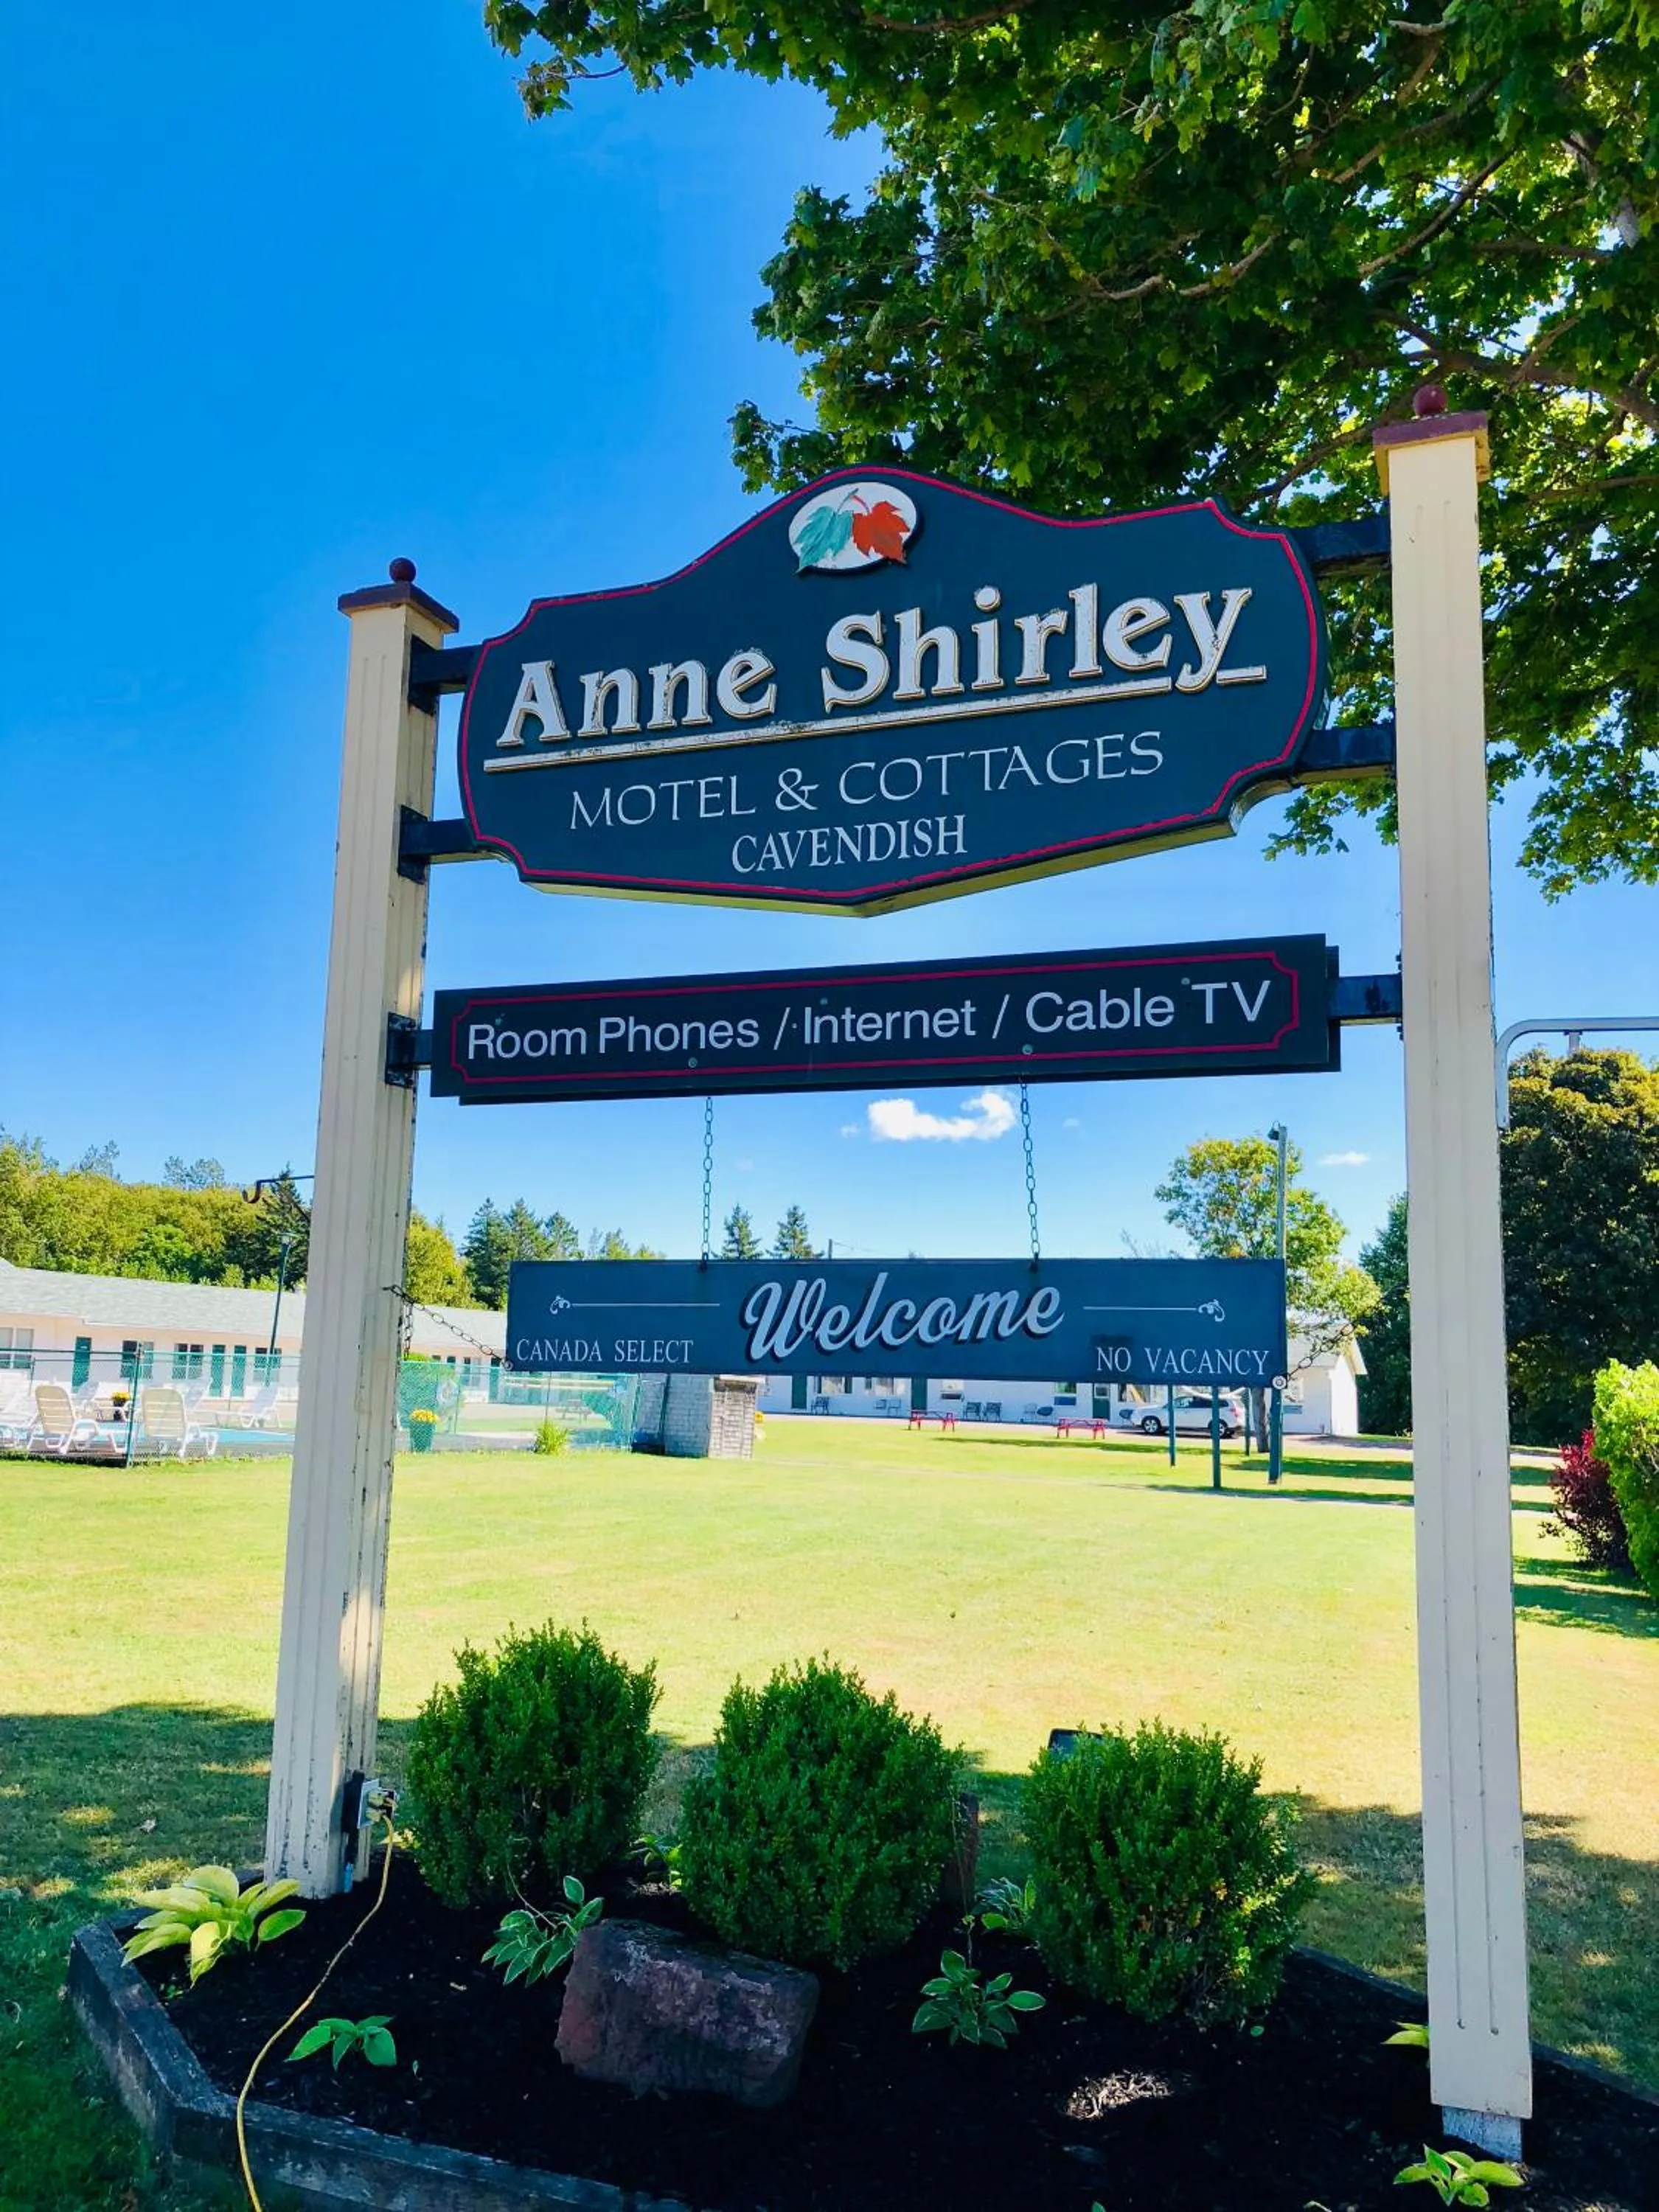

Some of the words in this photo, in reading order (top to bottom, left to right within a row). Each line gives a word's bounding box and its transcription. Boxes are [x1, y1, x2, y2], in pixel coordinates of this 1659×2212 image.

[497, 650, 777, 748] Anne
[821, 582, 1265, 713] Shirley
[570, 776, 756, 829] MOTEL
[775, 768, 818, 811] &
[838, 731, 1164, 804] COTTAGES
[731, 814, 968, 873] CAVENDISH
[467, 1023, 586, 1060] Room
[599, 1016, 759, 1054] Phones
[773, 1007, 791, 1051] /
[804, 999, 977, 1045] Internet
[992, 994, 1010, 1040] /
[1026, 987, 1175, 1033] Cable
[1191, 980, 1270, 1024] TV
[516, 1338, 603, 1363] CANADA
[614, 1339, 694, 1364] SELECT
[744, 1272, 1065, 1361] Welcome
[1096, 1346, 1132, 1372] NO
[1144, 1348, 1270, 1376] VACANCY
